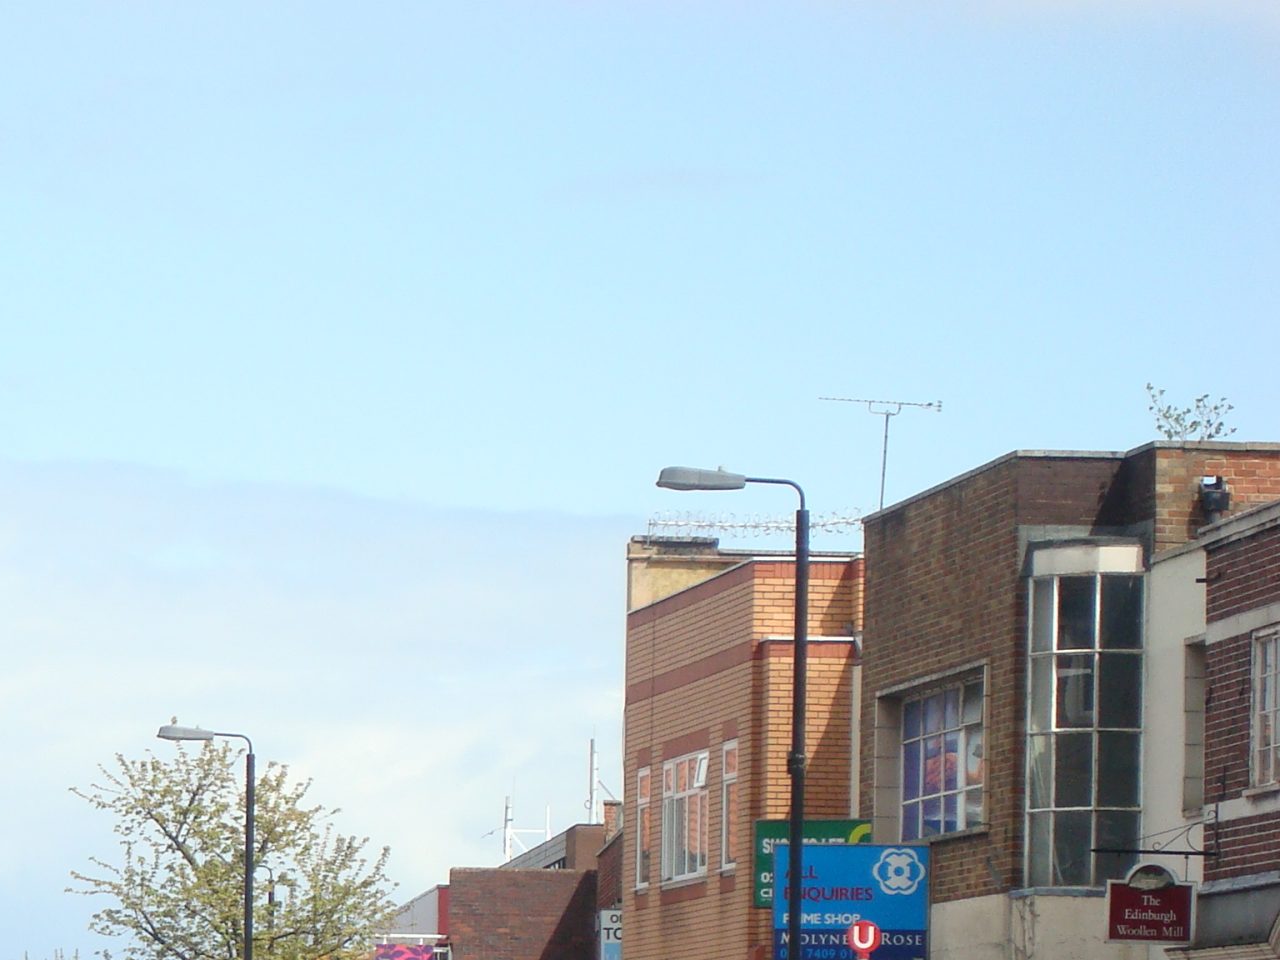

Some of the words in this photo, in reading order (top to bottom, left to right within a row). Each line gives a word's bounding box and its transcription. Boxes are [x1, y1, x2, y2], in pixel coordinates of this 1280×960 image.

[1141, 895, 1161, 906] The
[783, 913, 822, 925] PIME
[1124, 908, 1177, 923] Edinburgh
[1116, 924, 1157, 936] Woollen
[1162, 926, 1184, 937] Mill
[881, 932, 923, 946] ROSE
